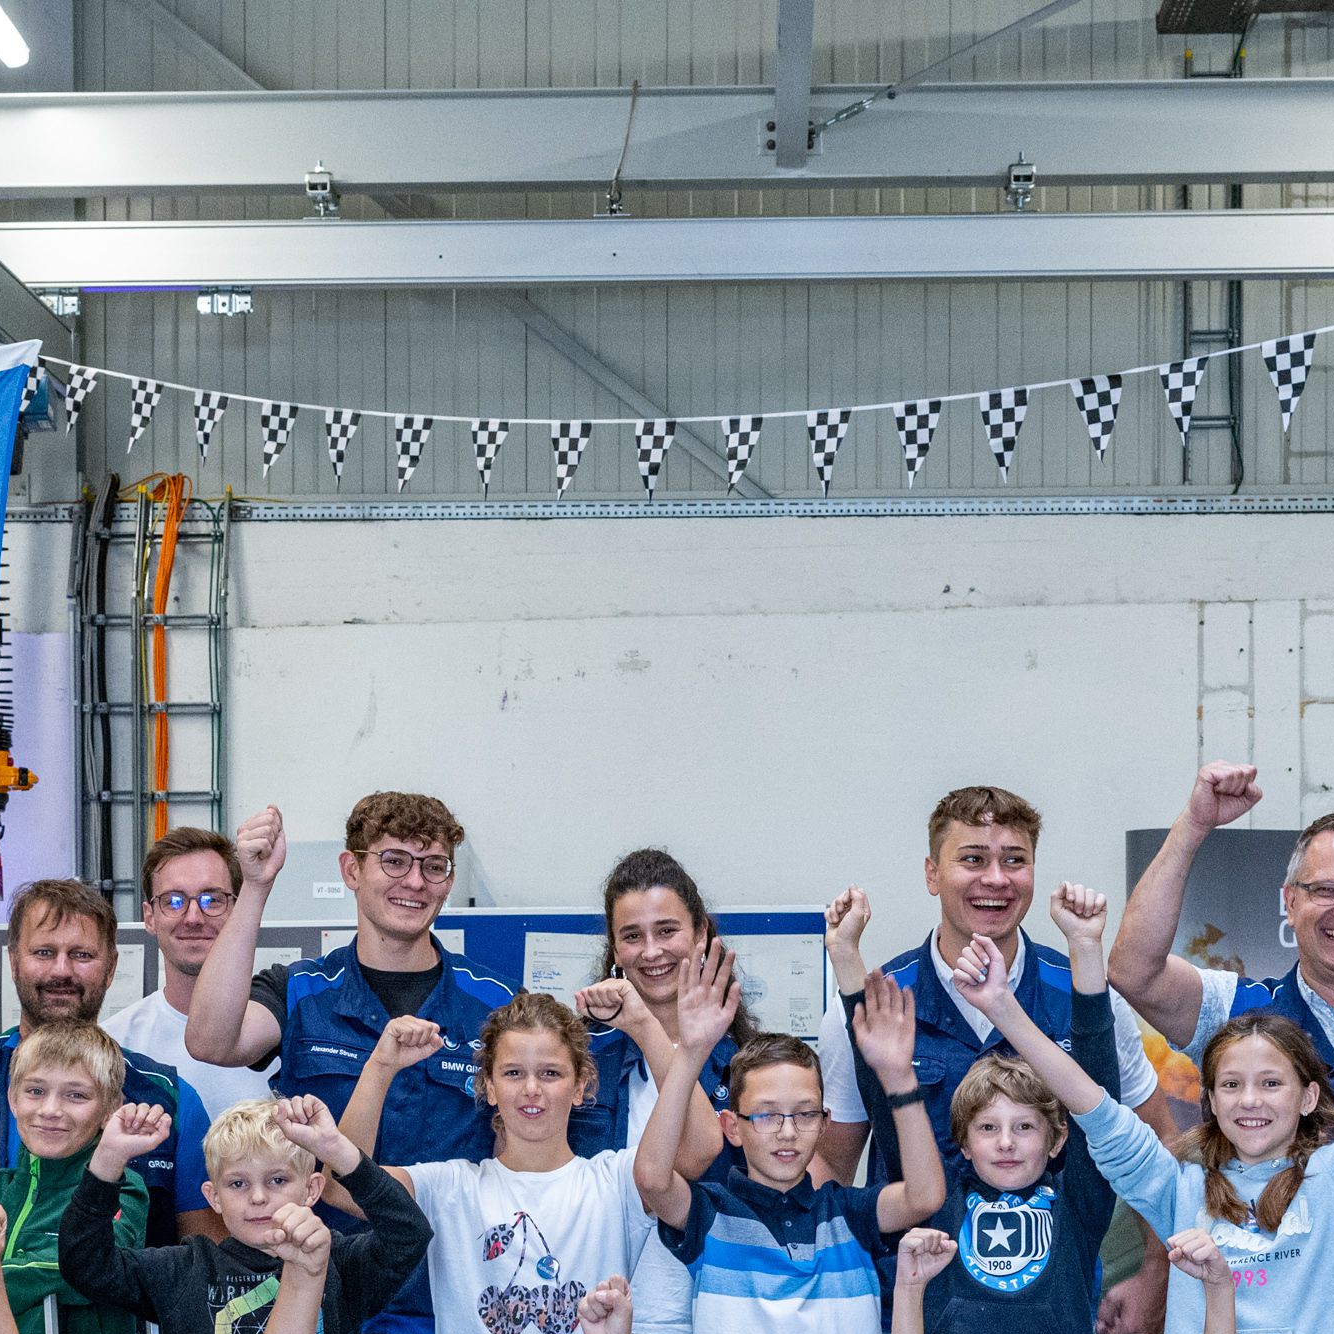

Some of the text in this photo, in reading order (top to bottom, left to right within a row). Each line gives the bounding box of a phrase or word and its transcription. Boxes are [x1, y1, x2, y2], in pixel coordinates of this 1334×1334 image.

[311, 1045, 339, 1055] Alexander
[441, 1060, 465, 1071] BMW
[148, 1160, 174, 1170] GROUP
[1273, 1248, 1301, 1261] RIVER
[987, 1260, 1013, 1272] 1908
[997, 1264, 1043, 1290] STAR
[1231, 1269, 1269, 1289] 993
